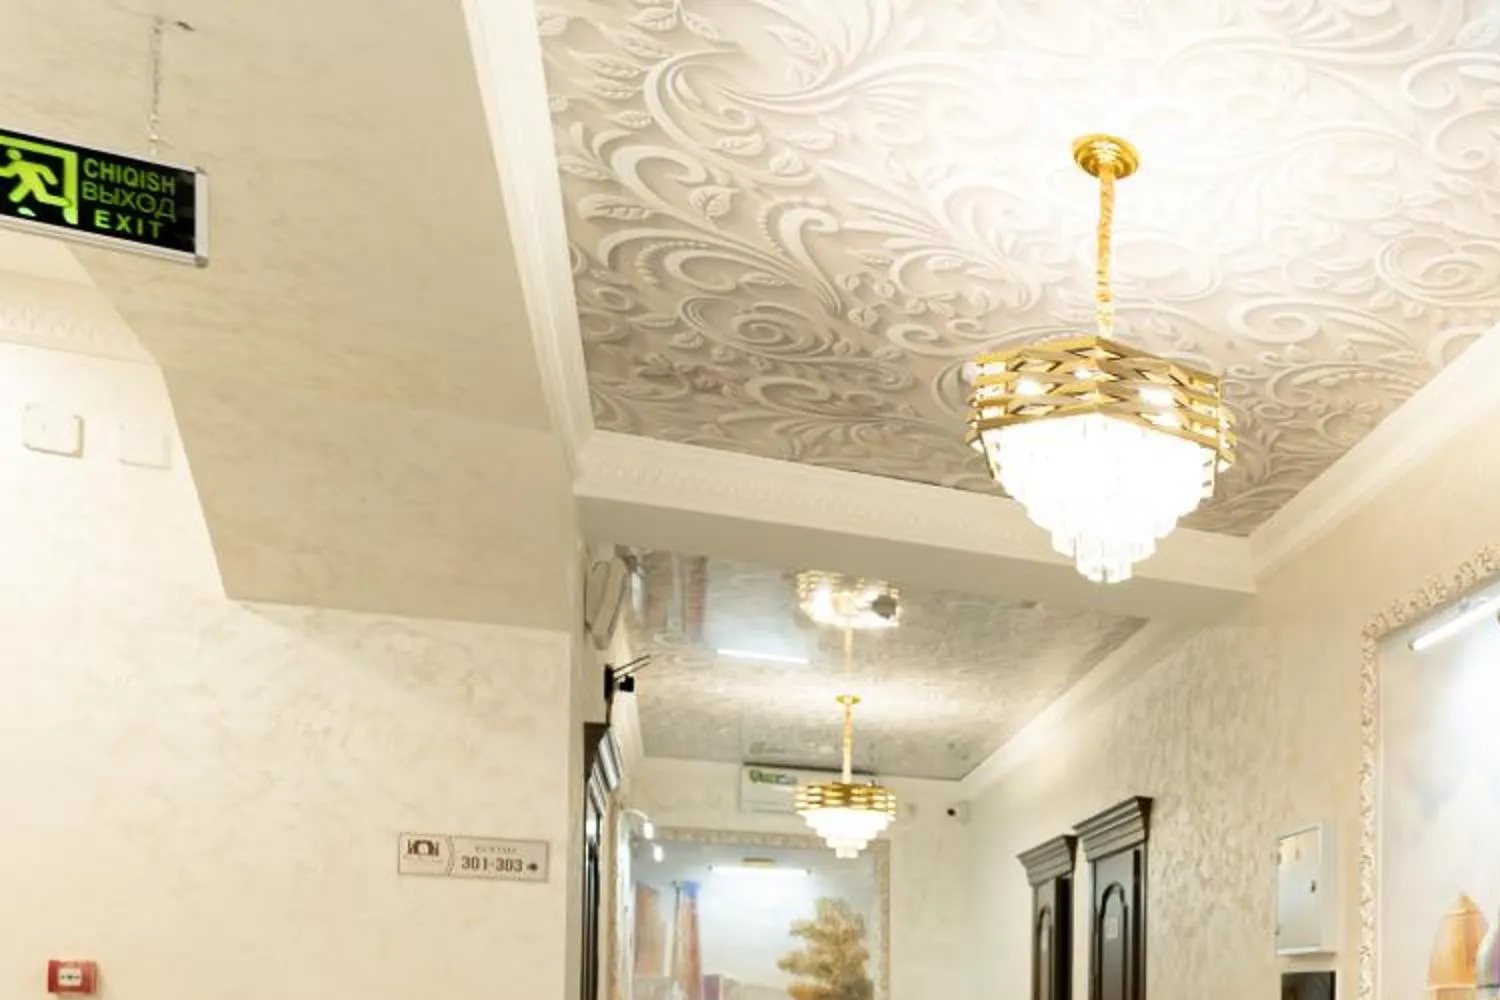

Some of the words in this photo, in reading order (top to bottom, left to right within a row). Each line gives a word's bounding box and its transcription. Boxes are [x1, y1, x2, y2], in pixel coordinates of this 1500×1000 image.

[83, 157, 176, 196] CHIQISH
[81, 180, 177, 223] ВЫХОД
[94, 208, 164, 239] EXIT
